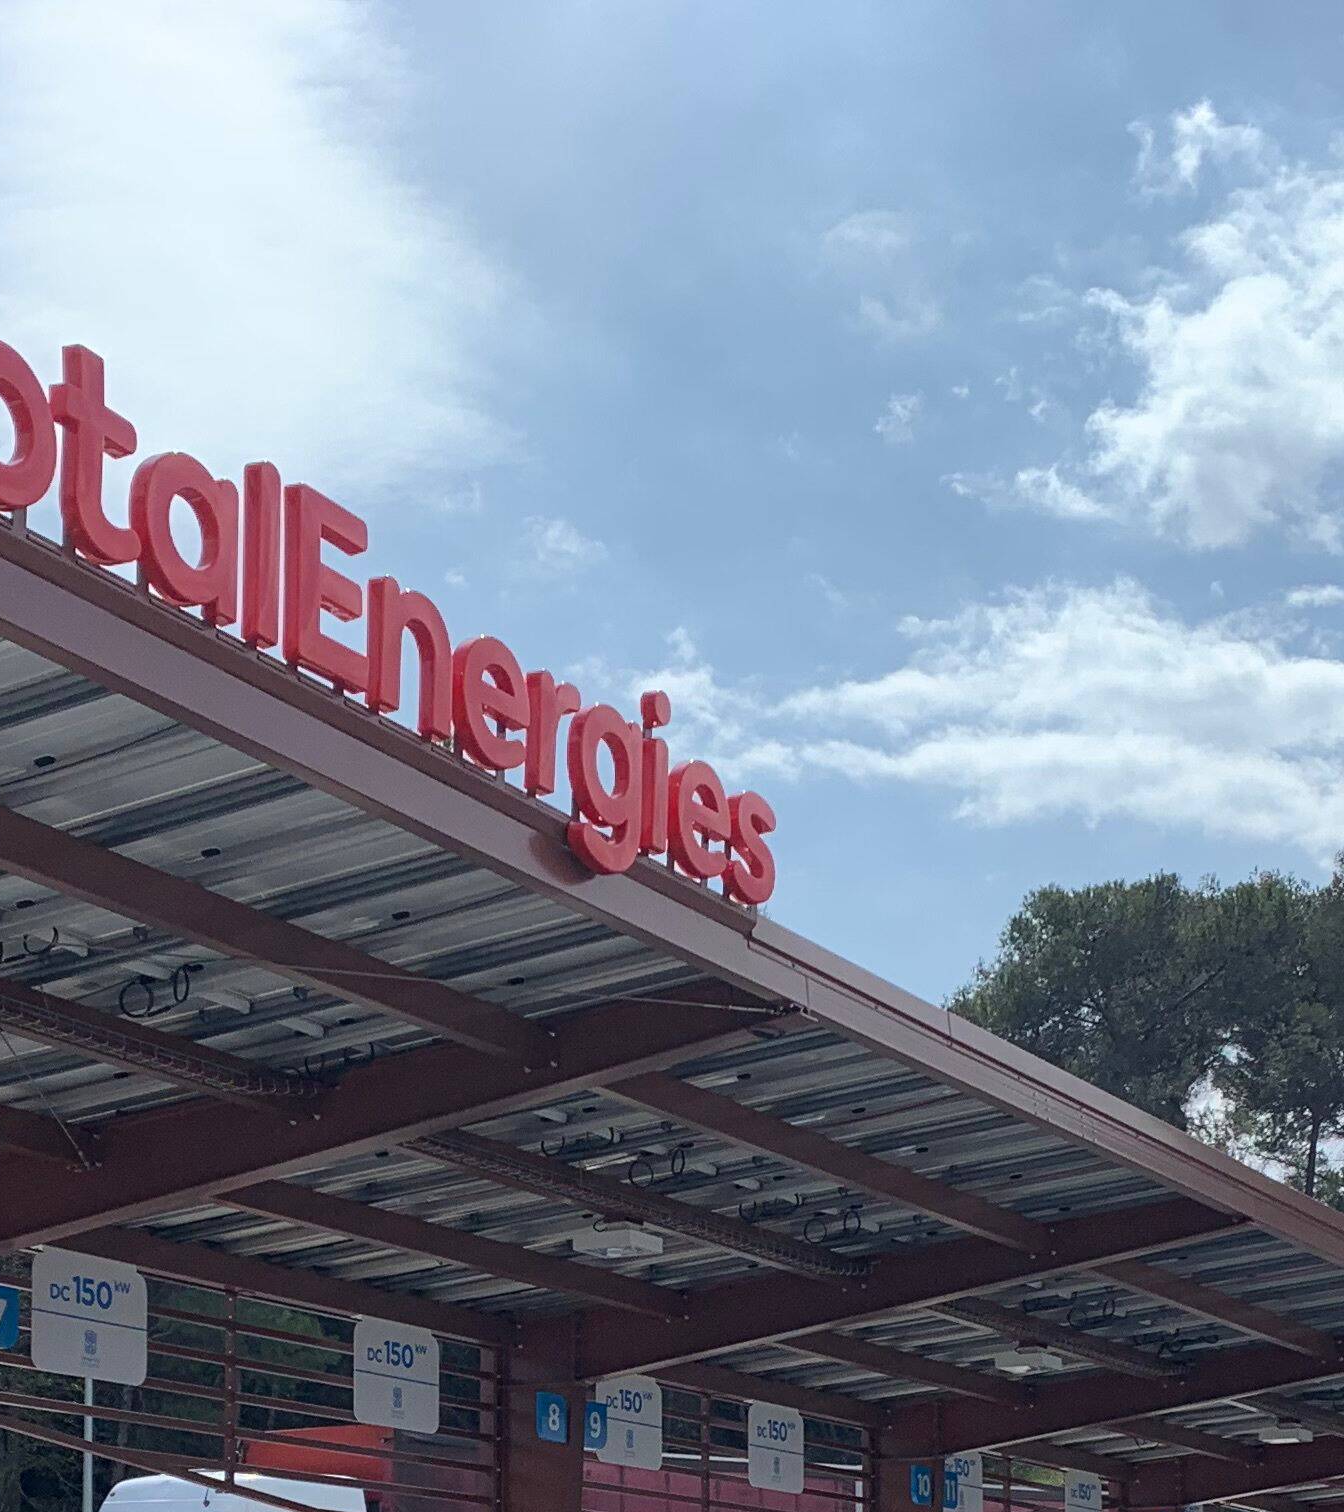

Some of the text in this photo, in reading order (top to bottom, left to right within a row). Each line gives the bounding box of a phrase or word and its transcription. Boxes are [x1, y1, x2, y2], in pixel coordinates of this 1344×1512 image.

[50, 1283, 70, 1301] DC
[72, 1276, 113, 1310] 150
[367, 1349, 382, 1363] DC
[384, 1340, 414, 1368] 150
[619, 1389, 642, 1413] 150
[548, 1403, 560, 1431] 8
[589, 1411, 601, 1438] 9
[768, 1419, 787, 1441] 150
[917, 1473, 931, 1497] 10
